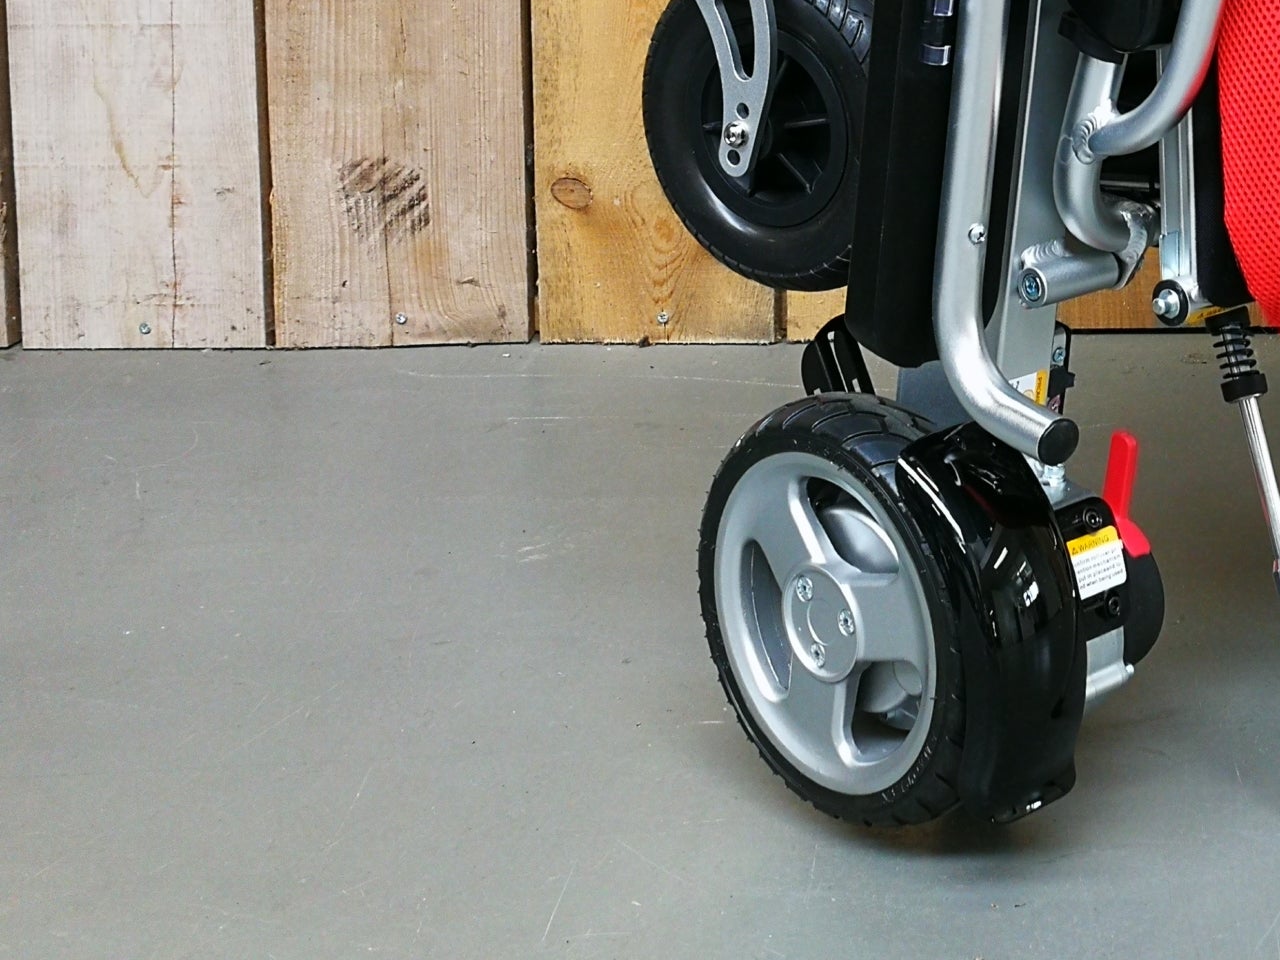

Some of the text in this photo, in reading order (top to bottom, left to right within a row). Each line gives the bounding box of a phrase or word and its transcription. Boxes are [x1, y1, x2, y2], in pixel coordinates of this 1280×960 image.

[1079, 535, 1109, 552] WARNING
[1074, 558, 1090, 567] onfirm
[1093, 554, 1121, 567] mechanism
[1099, 575, 1112, 583] being
[1112, 568, 1123, 577] used
